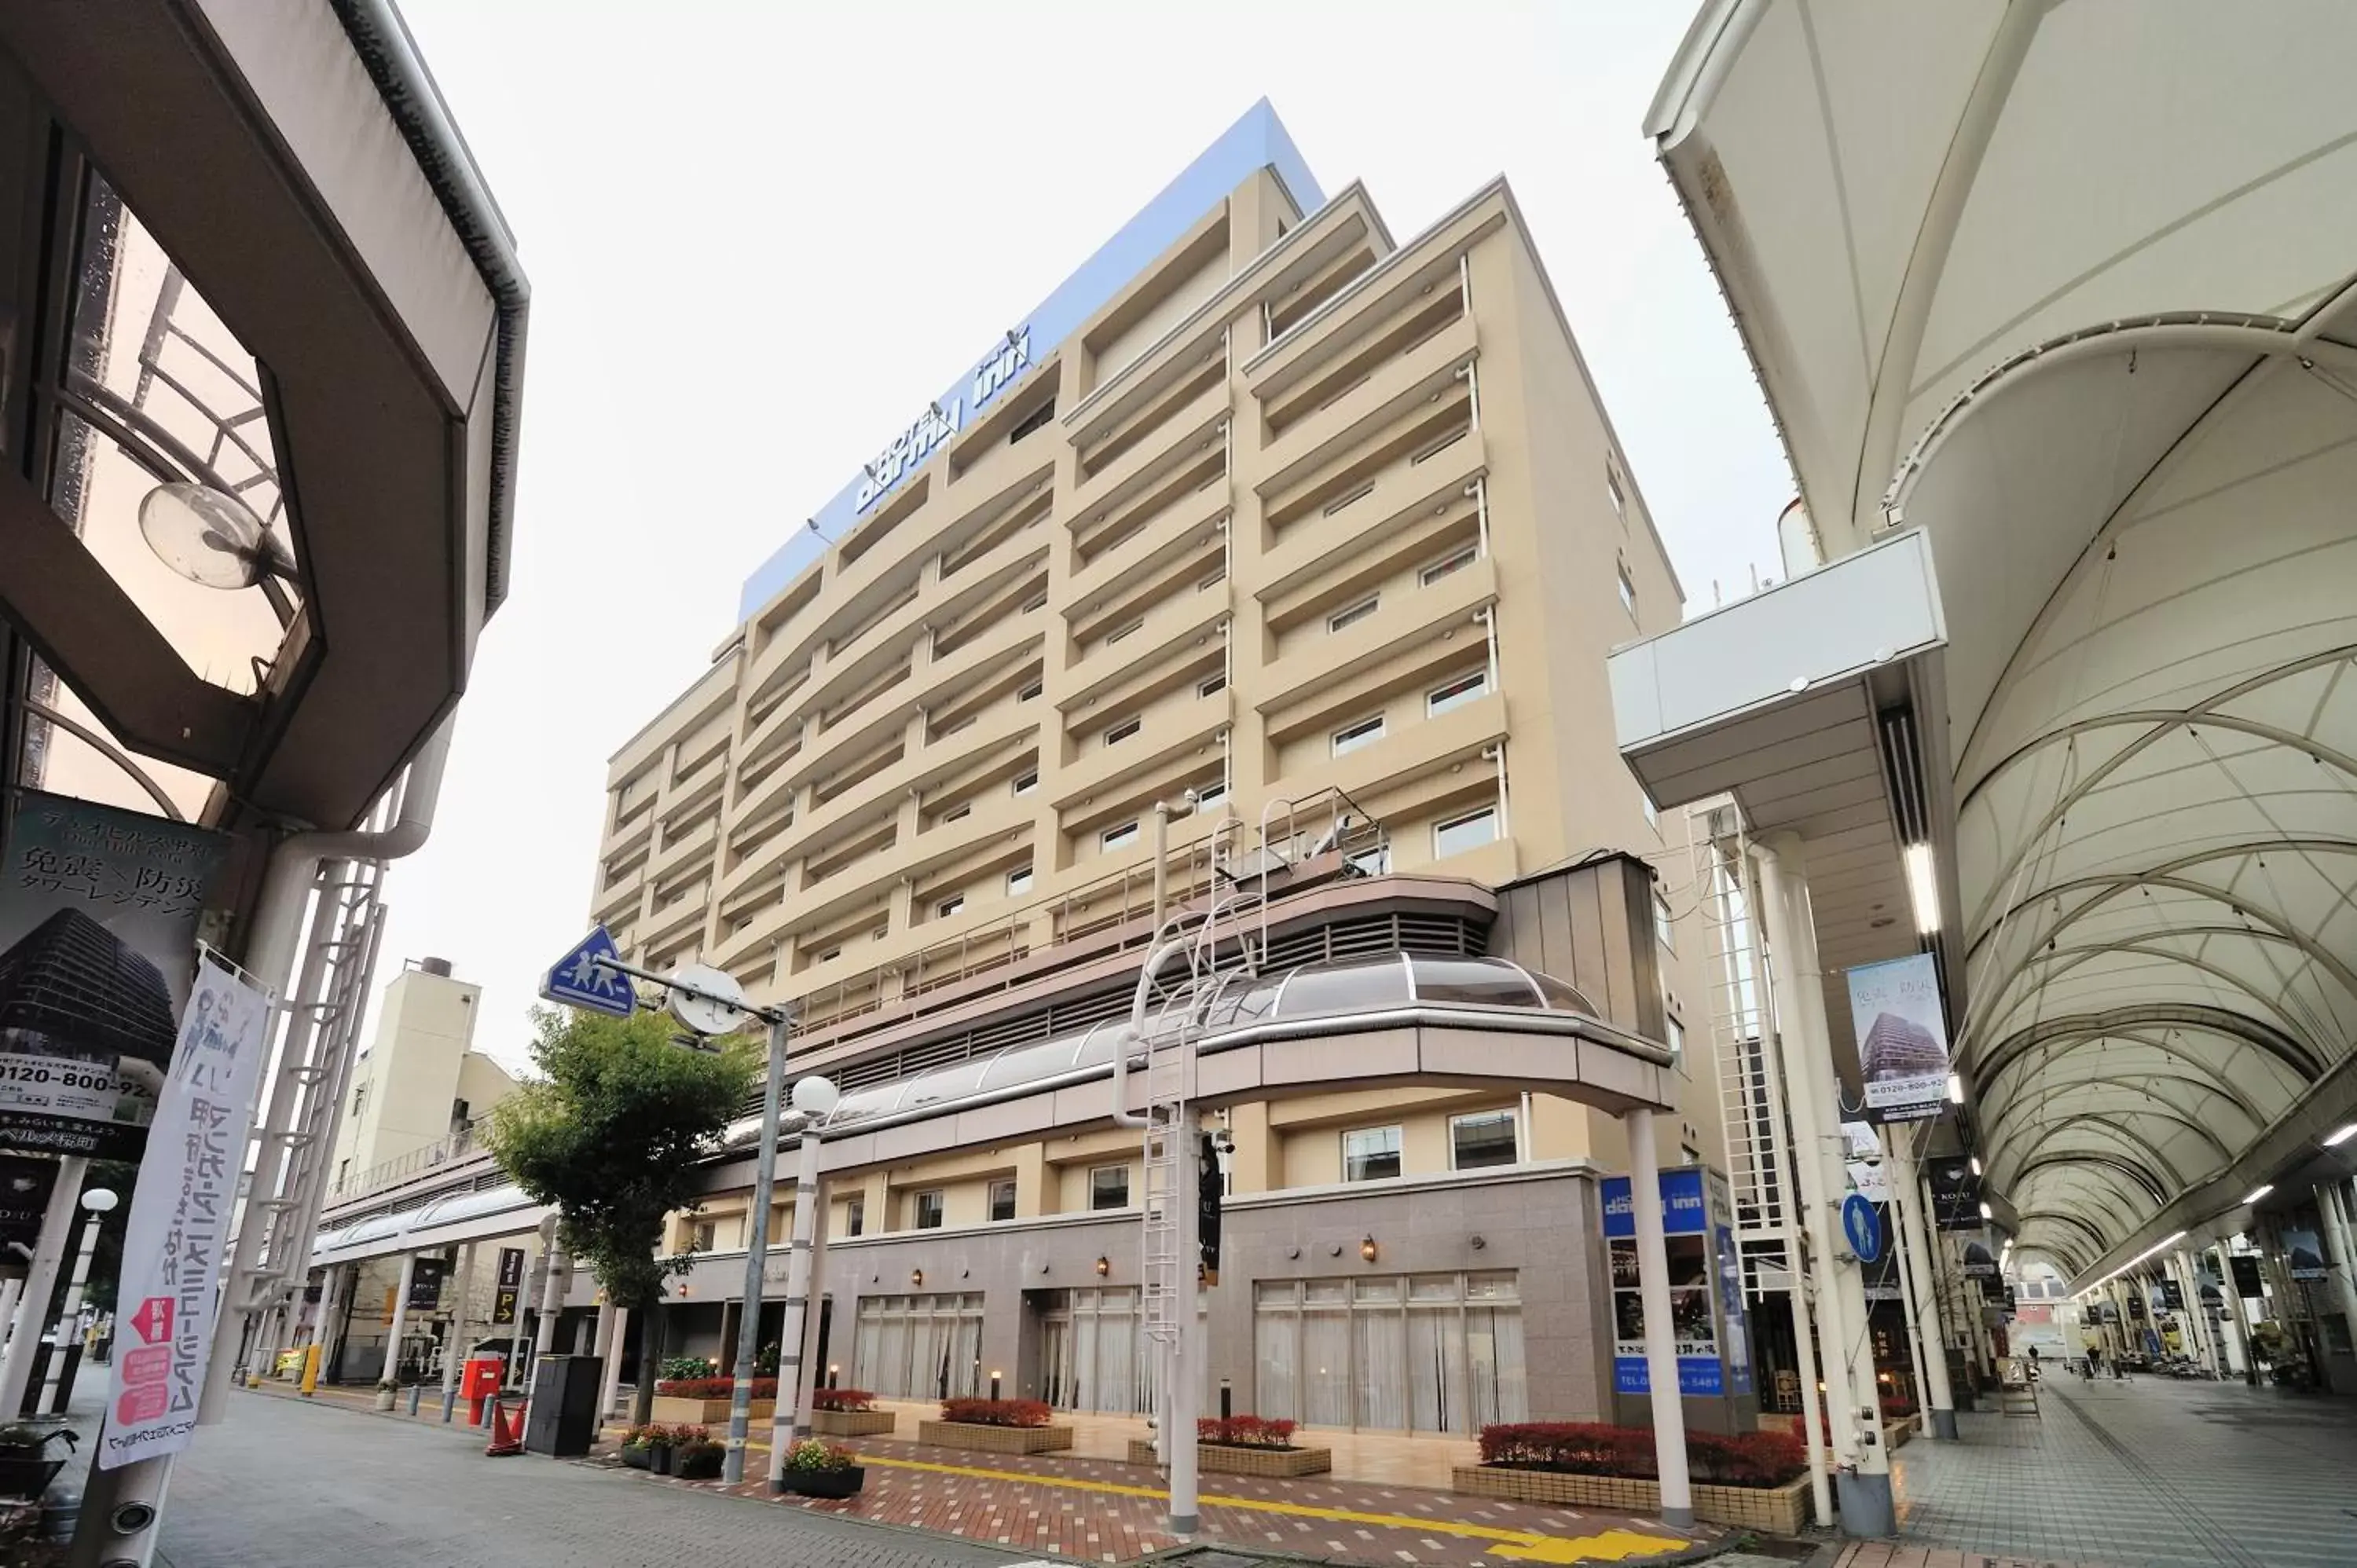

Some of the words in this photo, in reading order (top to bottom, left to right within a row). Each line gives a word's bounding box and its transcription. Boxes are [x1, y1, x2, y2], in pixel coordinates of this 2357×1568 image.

[973, 334, 1030, 410] inn
[1673, 1197, 1702, 1209] inn
[501, 1294, 514, 1306] P
